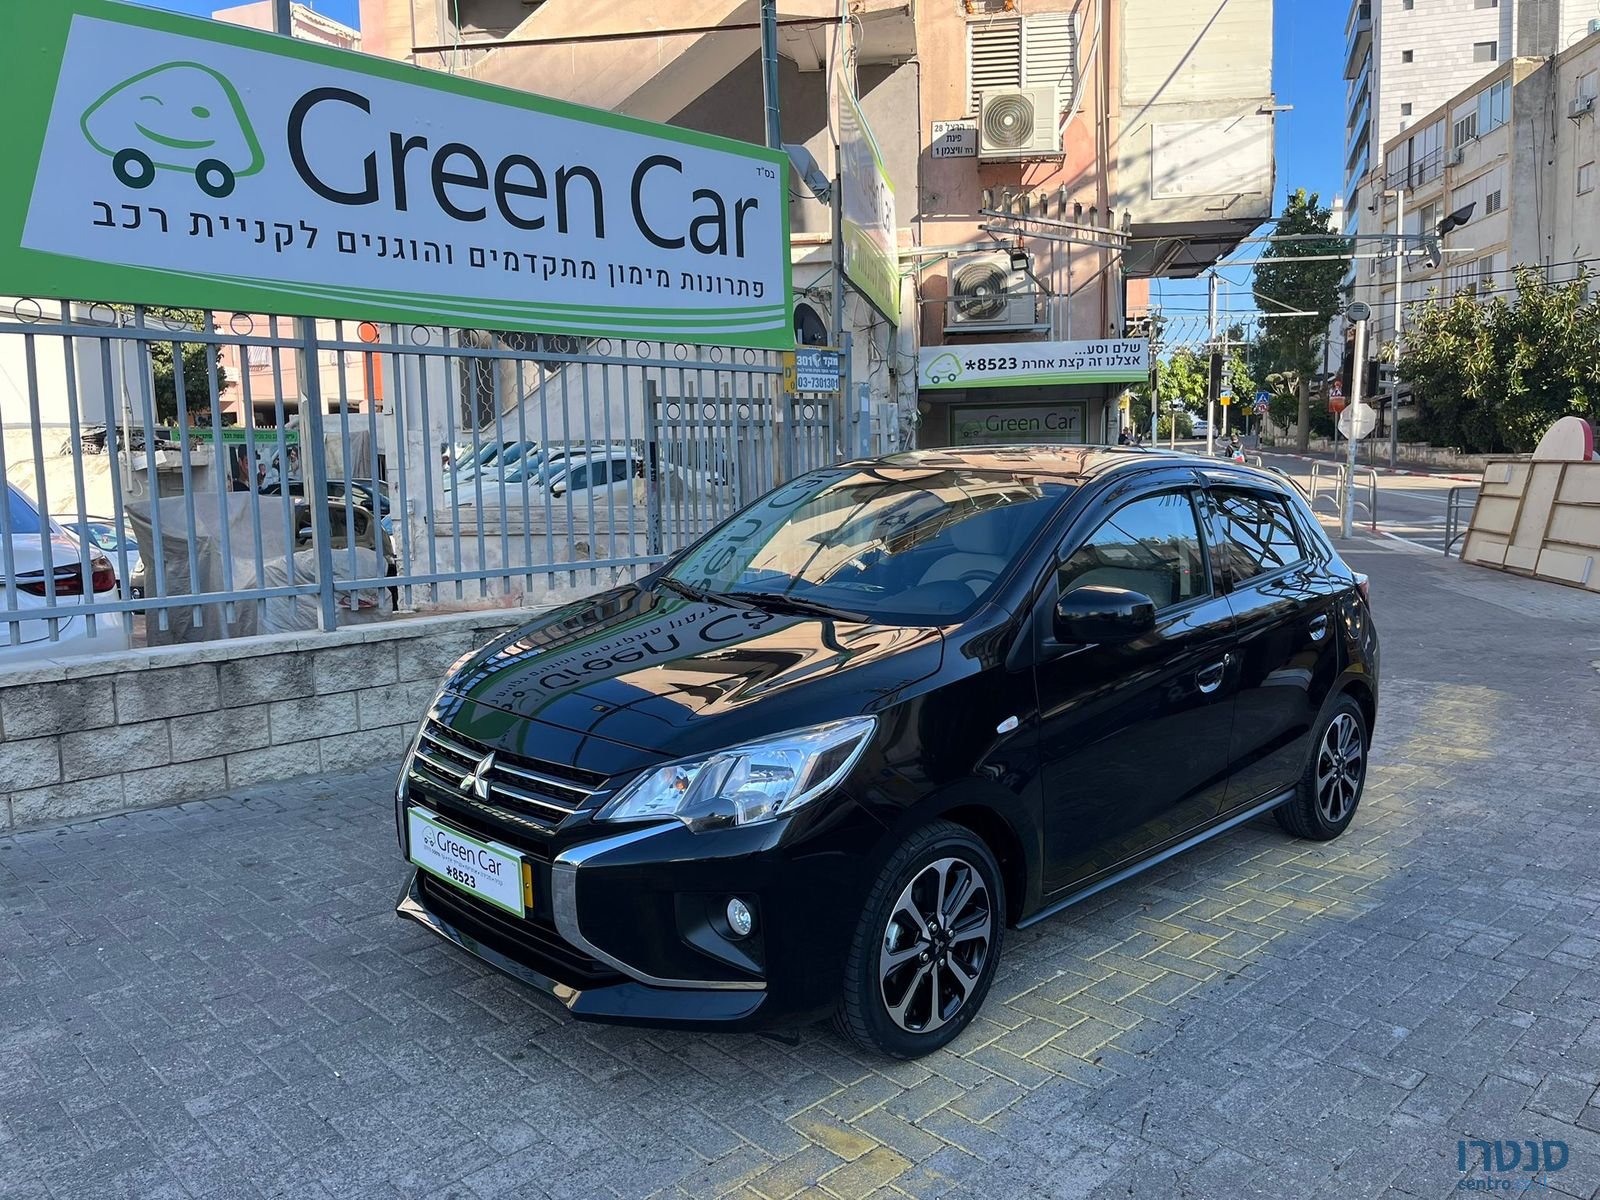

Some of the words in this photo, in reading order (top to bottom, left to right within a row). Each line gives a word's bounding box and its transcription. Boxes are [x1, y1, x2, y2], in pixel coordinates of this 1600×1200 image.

[934, 124, 943, 132] 28
[945, 122, 965, 131] הרצל
[946, 134, 962, 142] פינת
[287, 87, 605, 239] Green
[630, 155, 759, 258] Car
[93, 201, 168, 232] רכב
[189, 212, 318, 253] לקניית
[337, 230, 453, 265] והוגנים
[469, 245, 597, 280] מתקדמים
[608, 262, 670, 288] מימון
[681, 271, 765, 298] פתרונות
[1074, 344, 1108, 355] וסע...
[1113, 343, 1141, 353] שלם
[796, 356, 812, 366] 301
[1021, 359, 1055, 369] אחרת
[1058, 358, 1084, 369] קצת
[1088, 357, 1103, 366] זה
[1106, 355, 1141, 366] אצלנו
[985, 414, 1040, 432] Green
[1044, 412, 1076, 430] Car
[437, 831, 476, 865] Green
[478, 849, 502, 876] Car
